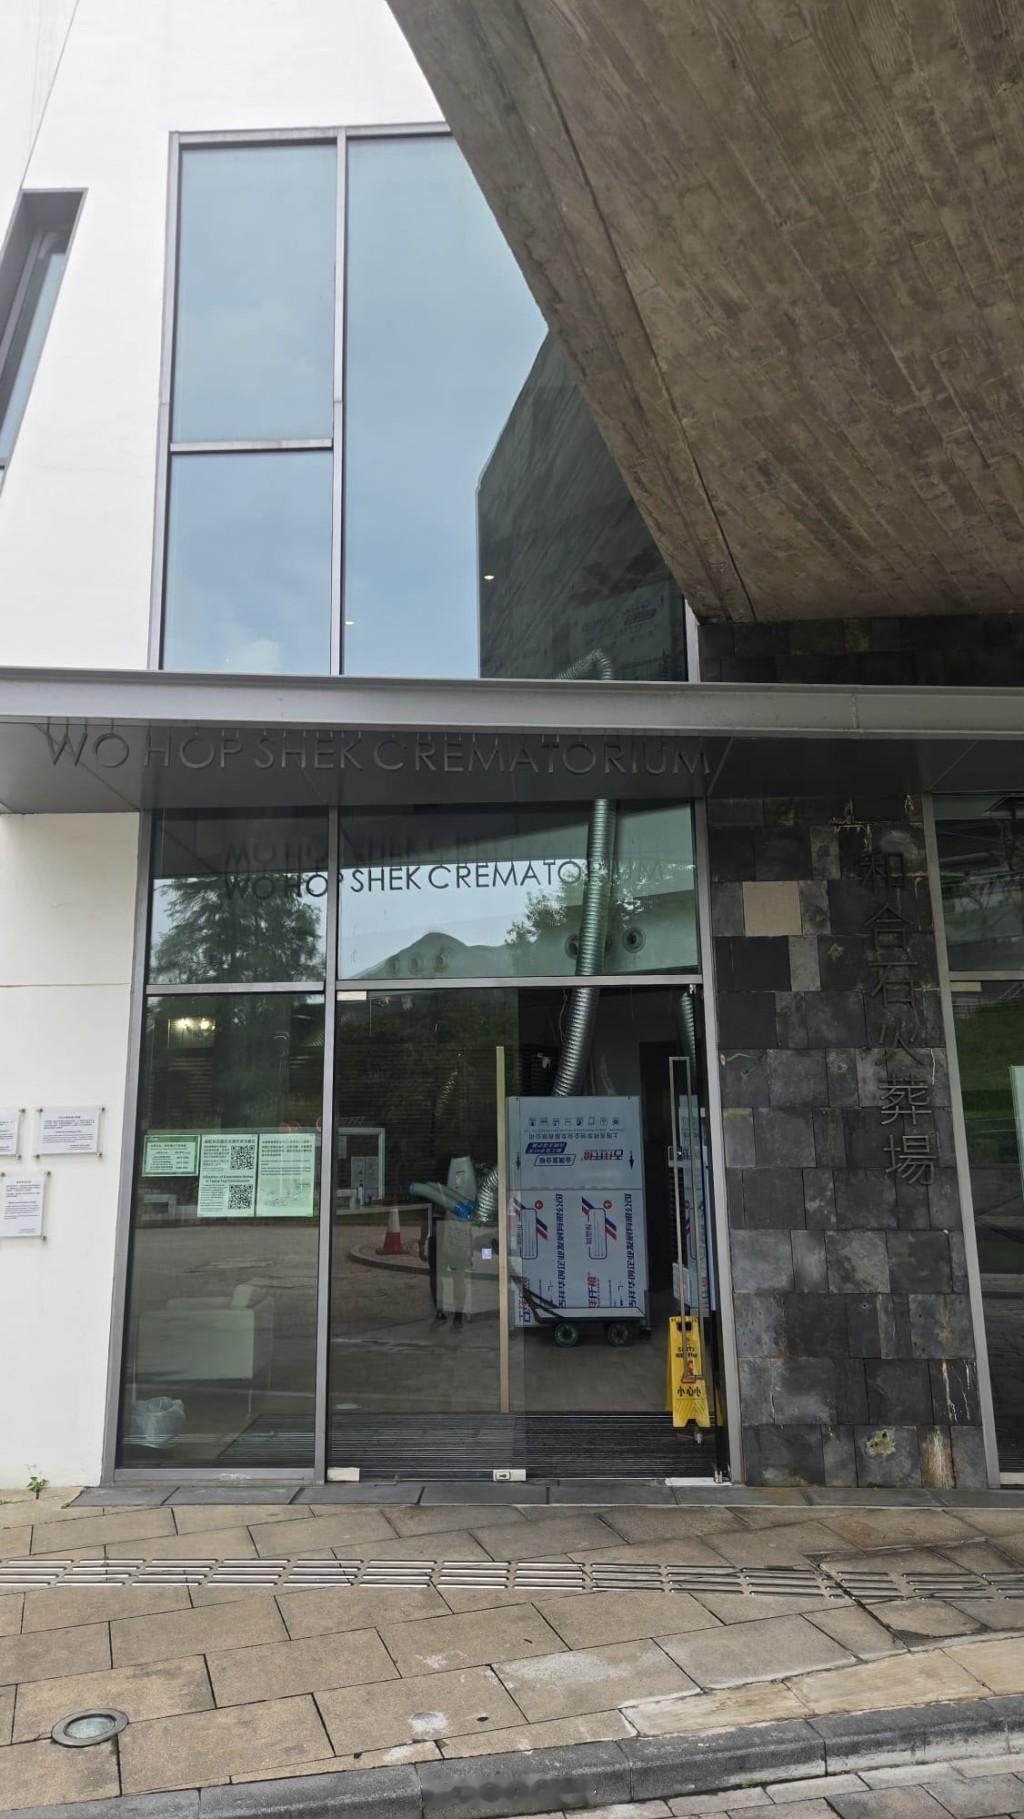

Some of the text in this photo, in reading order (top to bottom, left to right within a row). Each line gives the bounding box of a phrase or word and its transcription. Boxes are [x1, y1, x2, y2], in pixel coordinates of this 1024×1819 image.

[45, 731, 712, 775] WO HOP SHEK CREMATORIUM
[350, 866, 422, 892] SHEK
[857, 852, 937, 1186] 和合石火葬場
